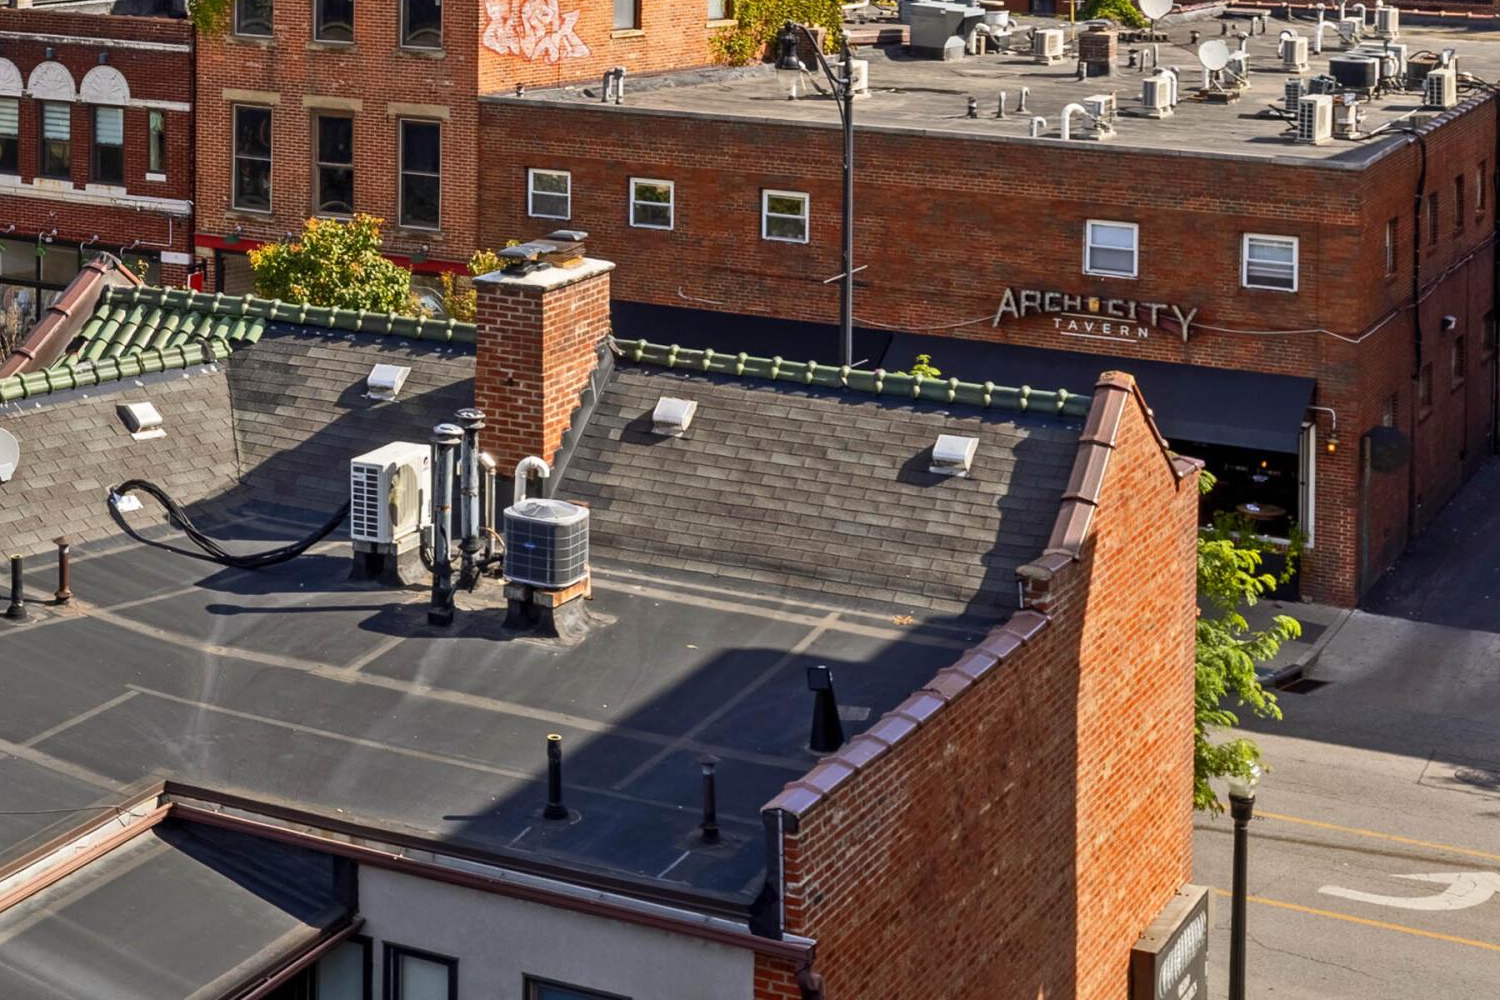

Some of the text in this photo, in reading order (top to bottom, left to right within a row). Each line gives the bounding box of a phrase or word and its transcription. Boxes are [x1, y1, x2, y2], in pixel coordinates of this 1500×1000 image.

[992, 288, 1198, 343] ARCH CITY
[1053, 317, 1149, 339] TAVERN
